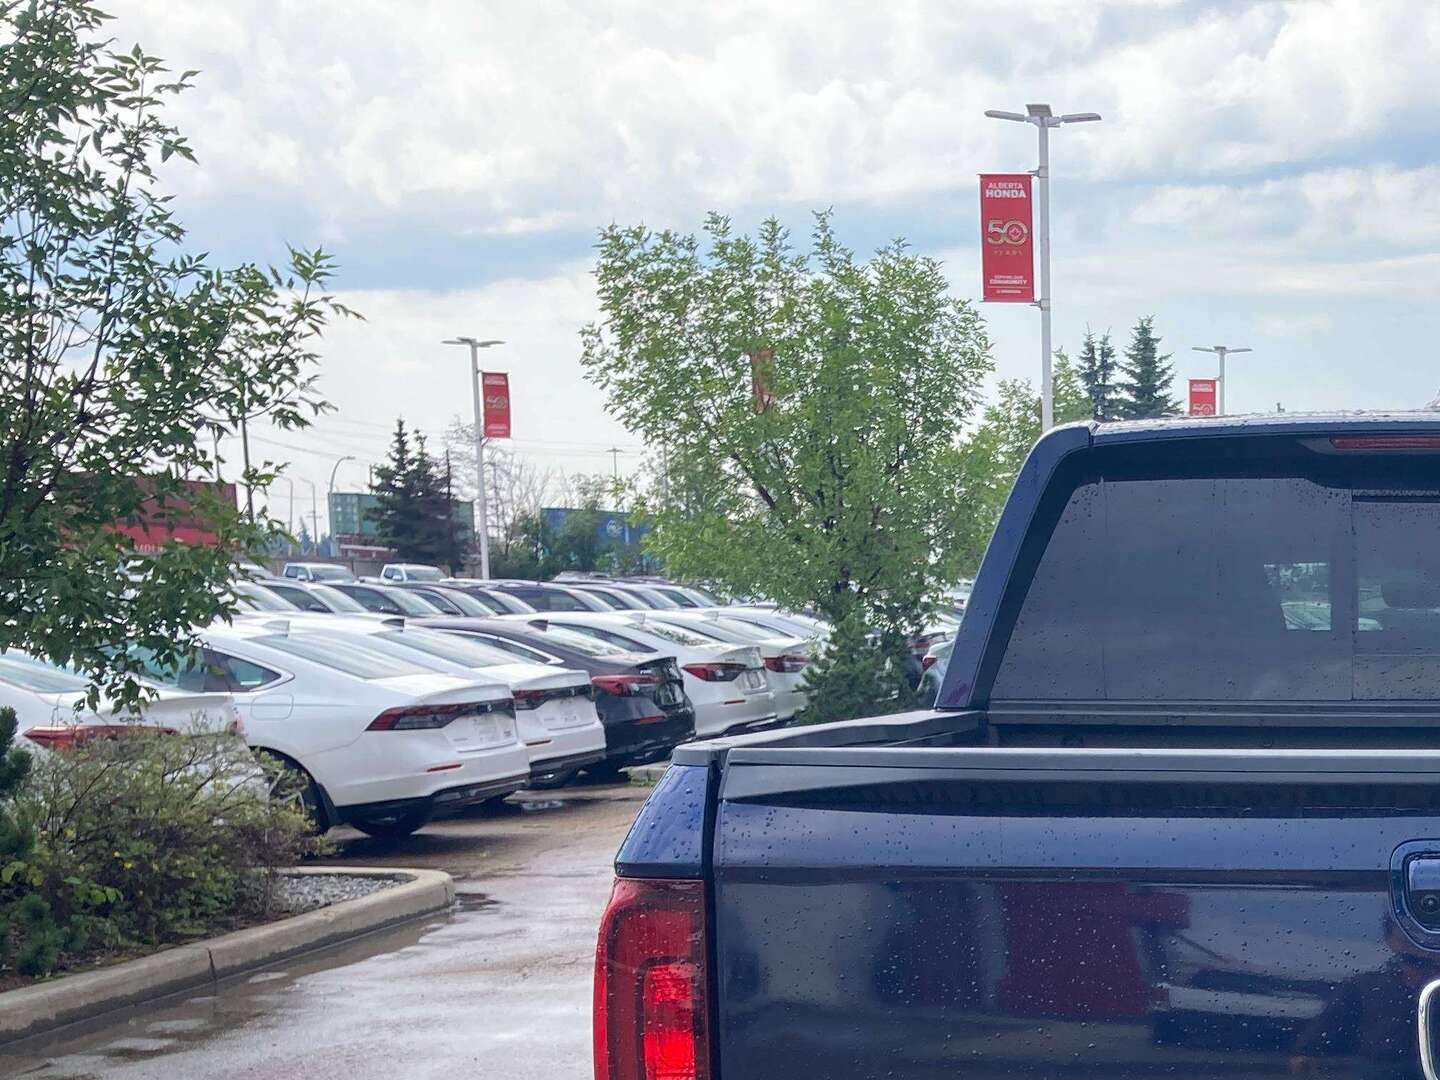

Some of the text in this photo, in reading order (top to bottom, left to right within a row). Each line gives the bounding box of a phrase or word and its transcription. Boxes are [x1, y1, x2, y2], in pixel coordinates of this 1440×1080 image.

[988, 182, 1023, 190] ALBERTA
[986, 190, 1026, 199] HONDA
[987, 219, 1028, 246] 50
